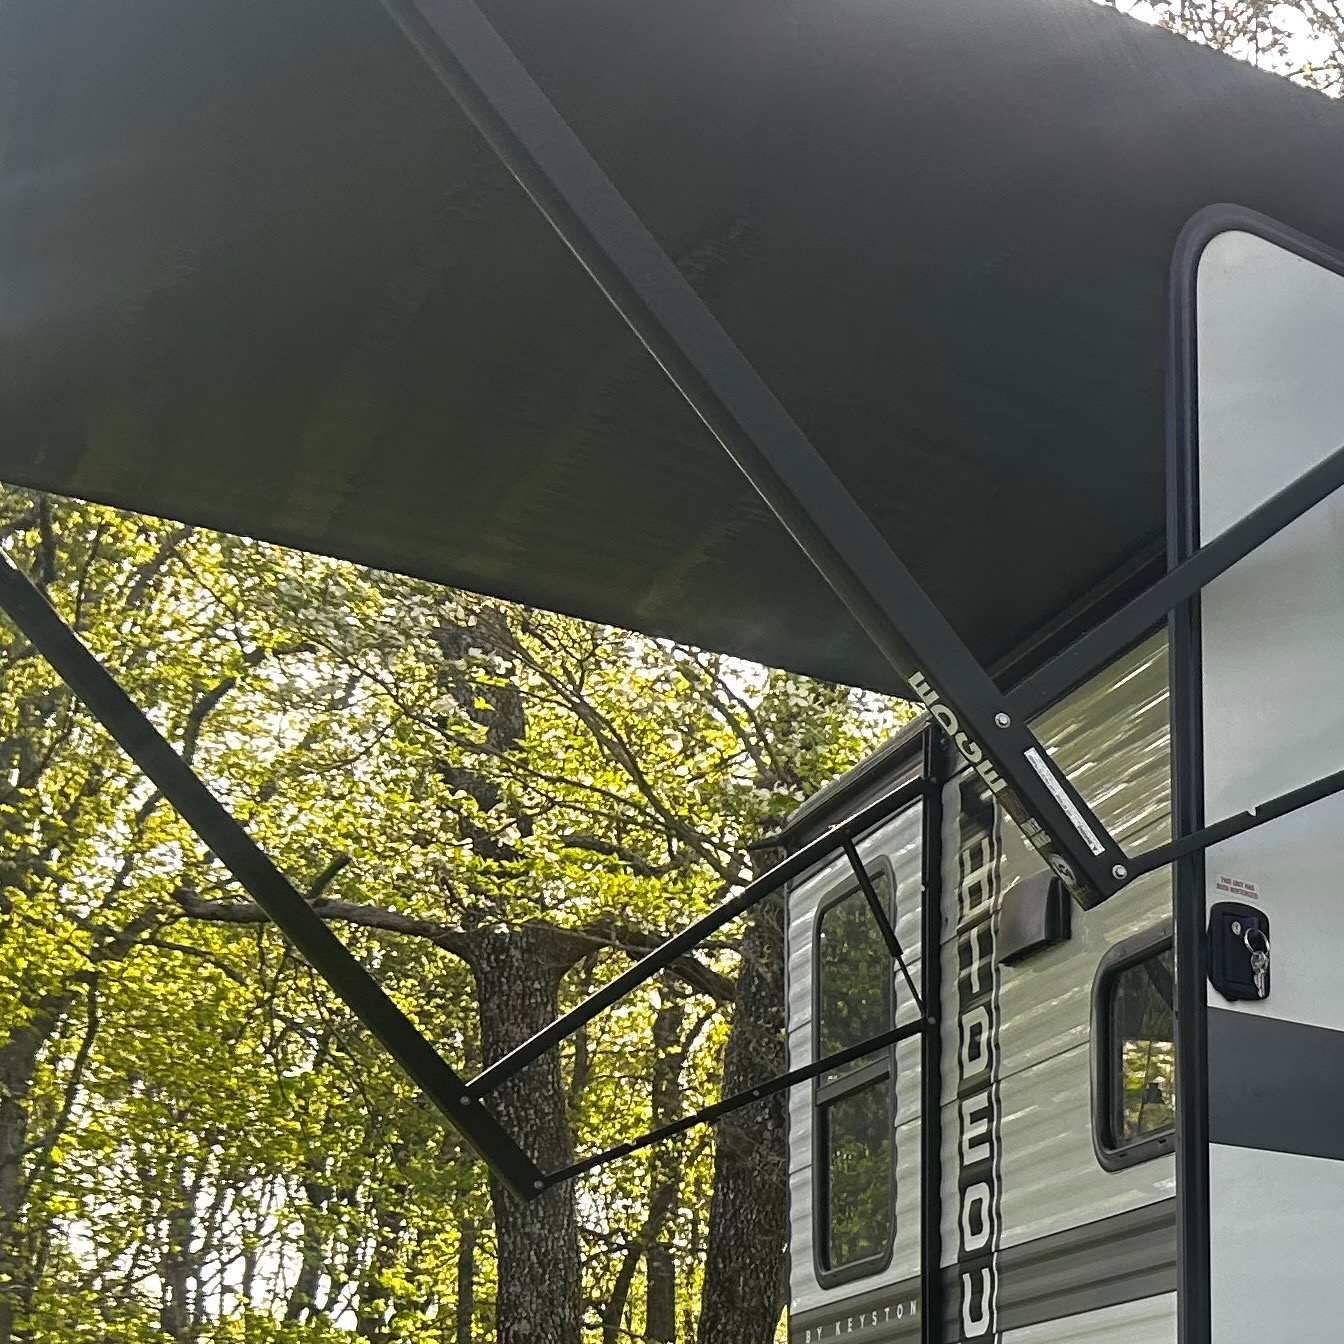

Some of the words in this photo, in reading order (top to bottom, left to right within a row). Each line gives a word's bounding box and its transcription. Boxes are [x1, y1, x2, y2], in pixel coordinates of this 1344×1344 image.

[908, 671, 1008, 793] EDGE
[806, 1326, 822, 1344] BY
[835, 1299, 917, 1336] KEYSTON
